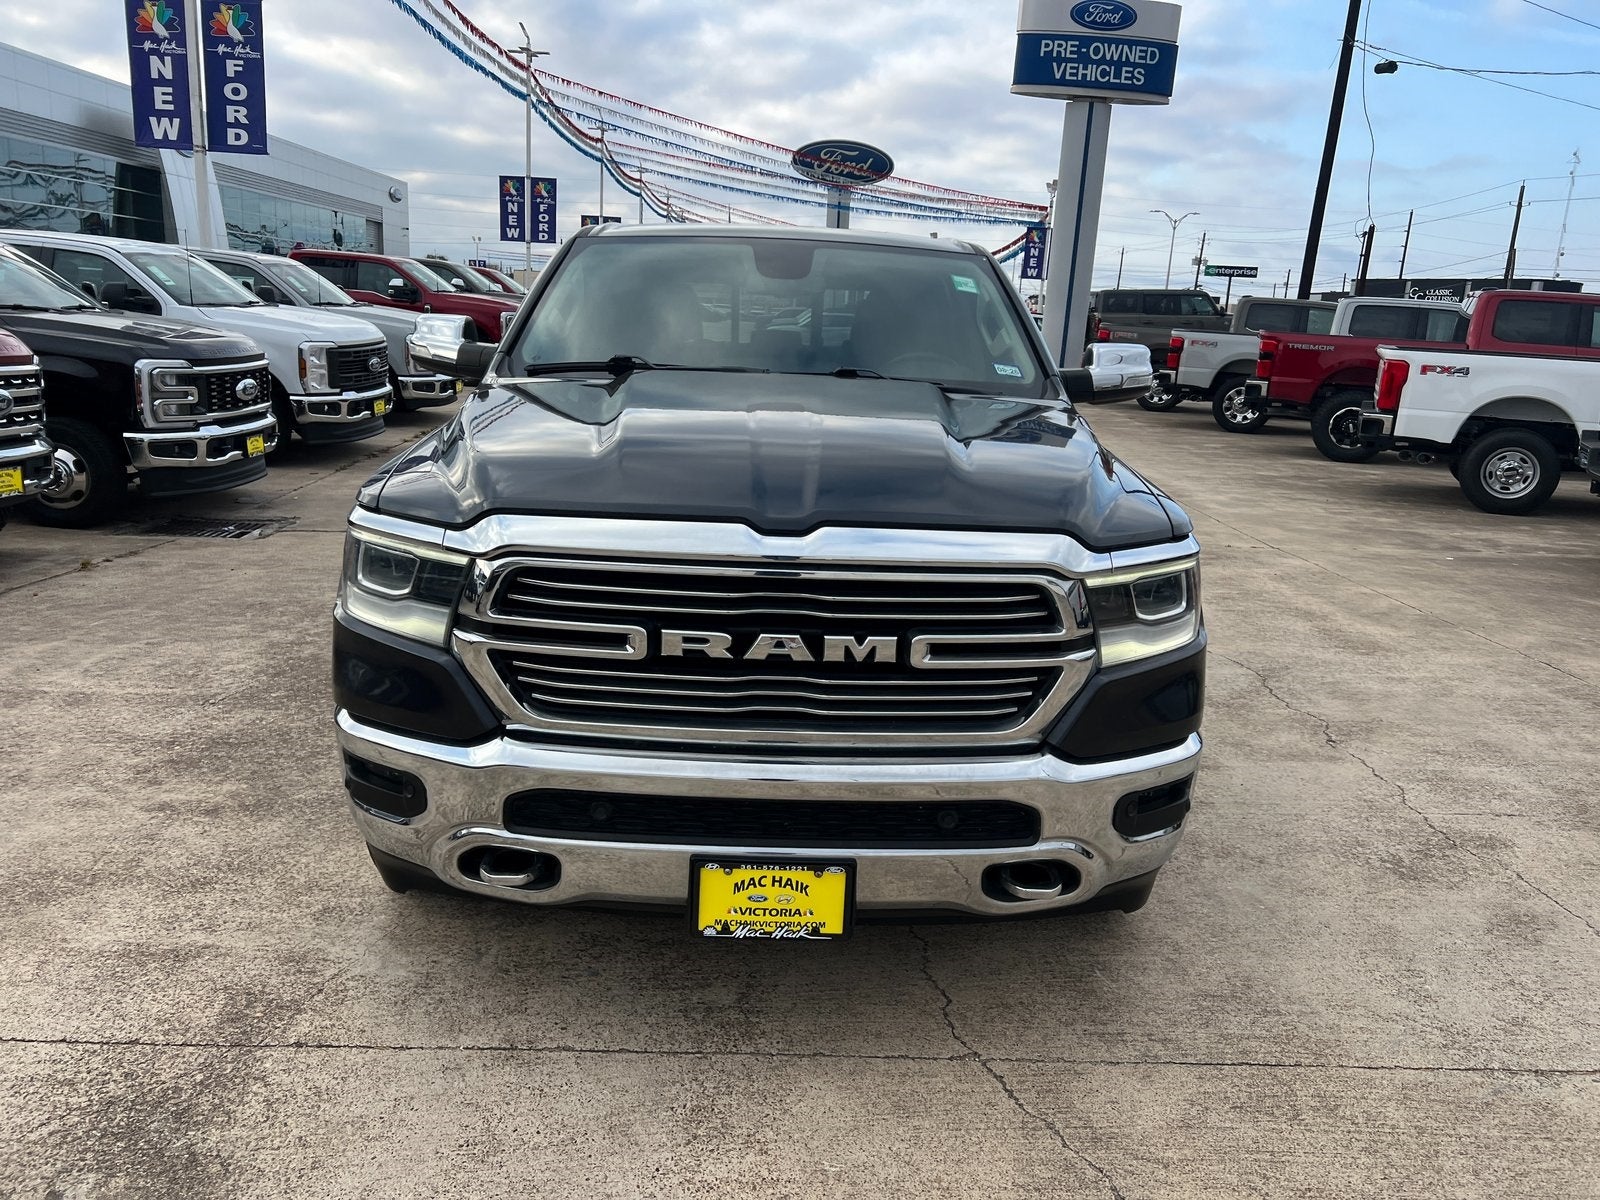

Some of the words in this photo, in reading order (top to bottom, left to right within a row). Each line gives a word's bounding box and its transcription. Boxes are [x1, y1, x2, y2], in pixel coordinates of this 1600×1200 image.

[1084, 3, 1122, 24] Ford
[1052, 62, 1145, 86] VEHICLES
[149, 55, 180, 140] NEW
[223, 59, 249, 146] FORD
[814, 148, 873, 177] Ford
[506, 202, 519, 238] NEW
[538, 204, 549, 240] FORD
[1027, 247, 1039, 277] NEW
[1206, 267, 1257, 276] enterprise
[1287, 342, 1335, 351] TREMOR
[1420, 364, 1470, 376] FX4
[661, 629, 898, 663] RAM
[733, 875, 768, 895] MAC
[771, 875, 810, 897] HAIK
[739, 906, 803, 917] VICTORIA
[731, 924, 768, 939] Mac
